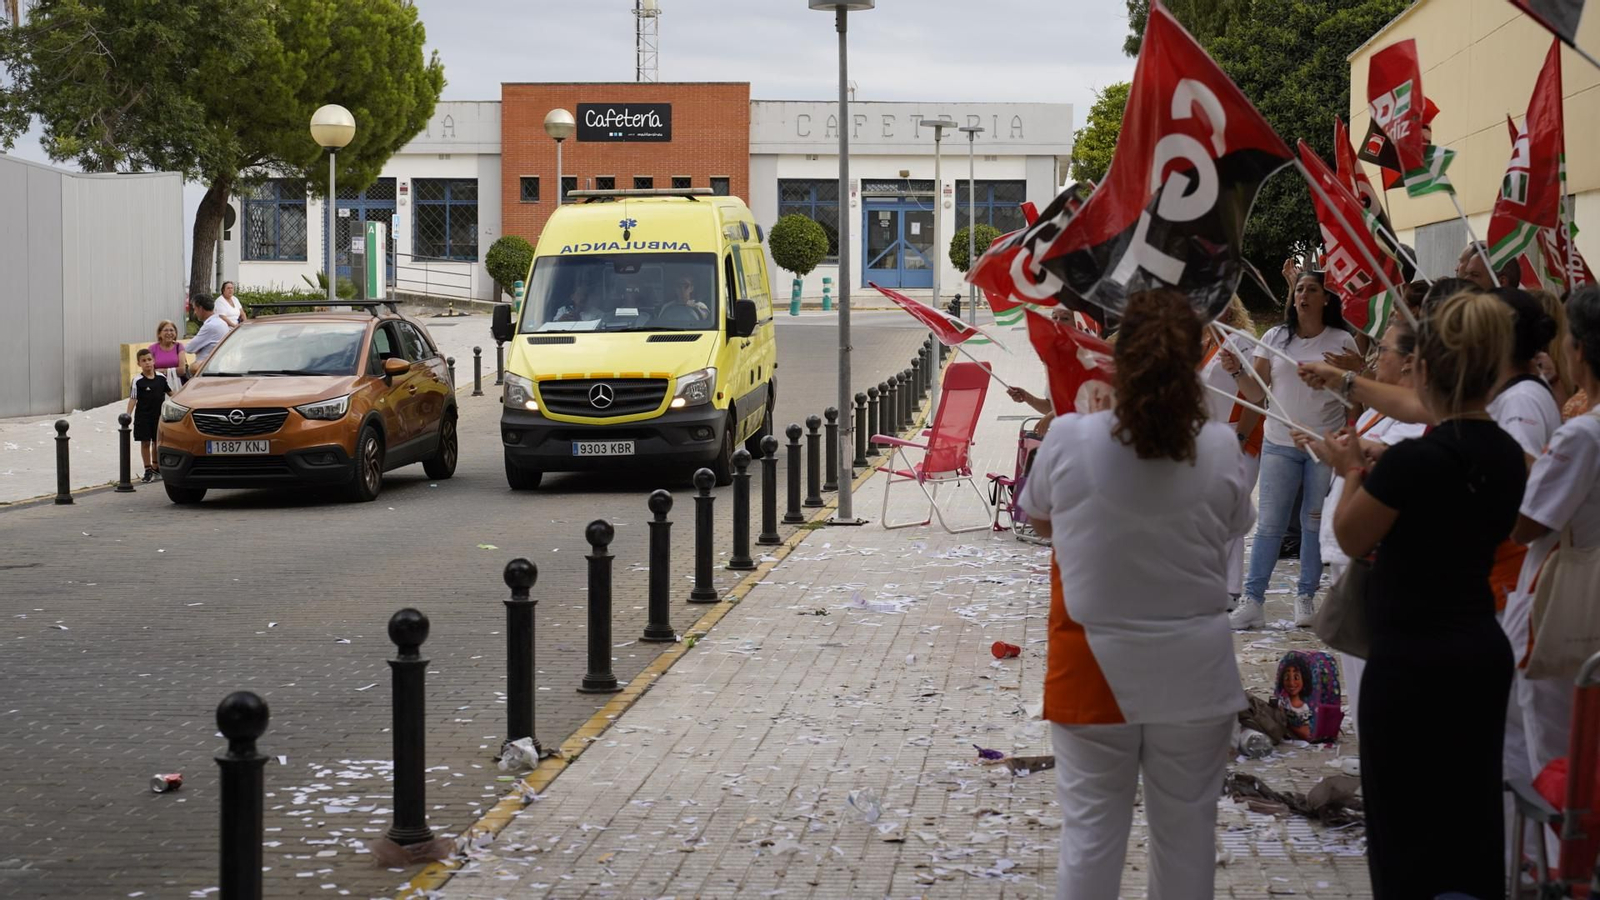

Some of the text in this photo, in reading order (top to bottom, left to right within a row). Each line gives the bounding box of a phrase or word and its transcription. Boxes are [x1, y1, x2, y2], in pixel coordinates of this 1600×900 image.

[585, 108, 663, 127] Cafetería
[796, 113, 1025, 139] CAFETERIA
[1110, 78, 1227, 287] CGT
[368, 226, 375, 234] A
[215, 441, 267, 453] 1887 KNJ
[580, 442, 632, 454] 9303 KBR
